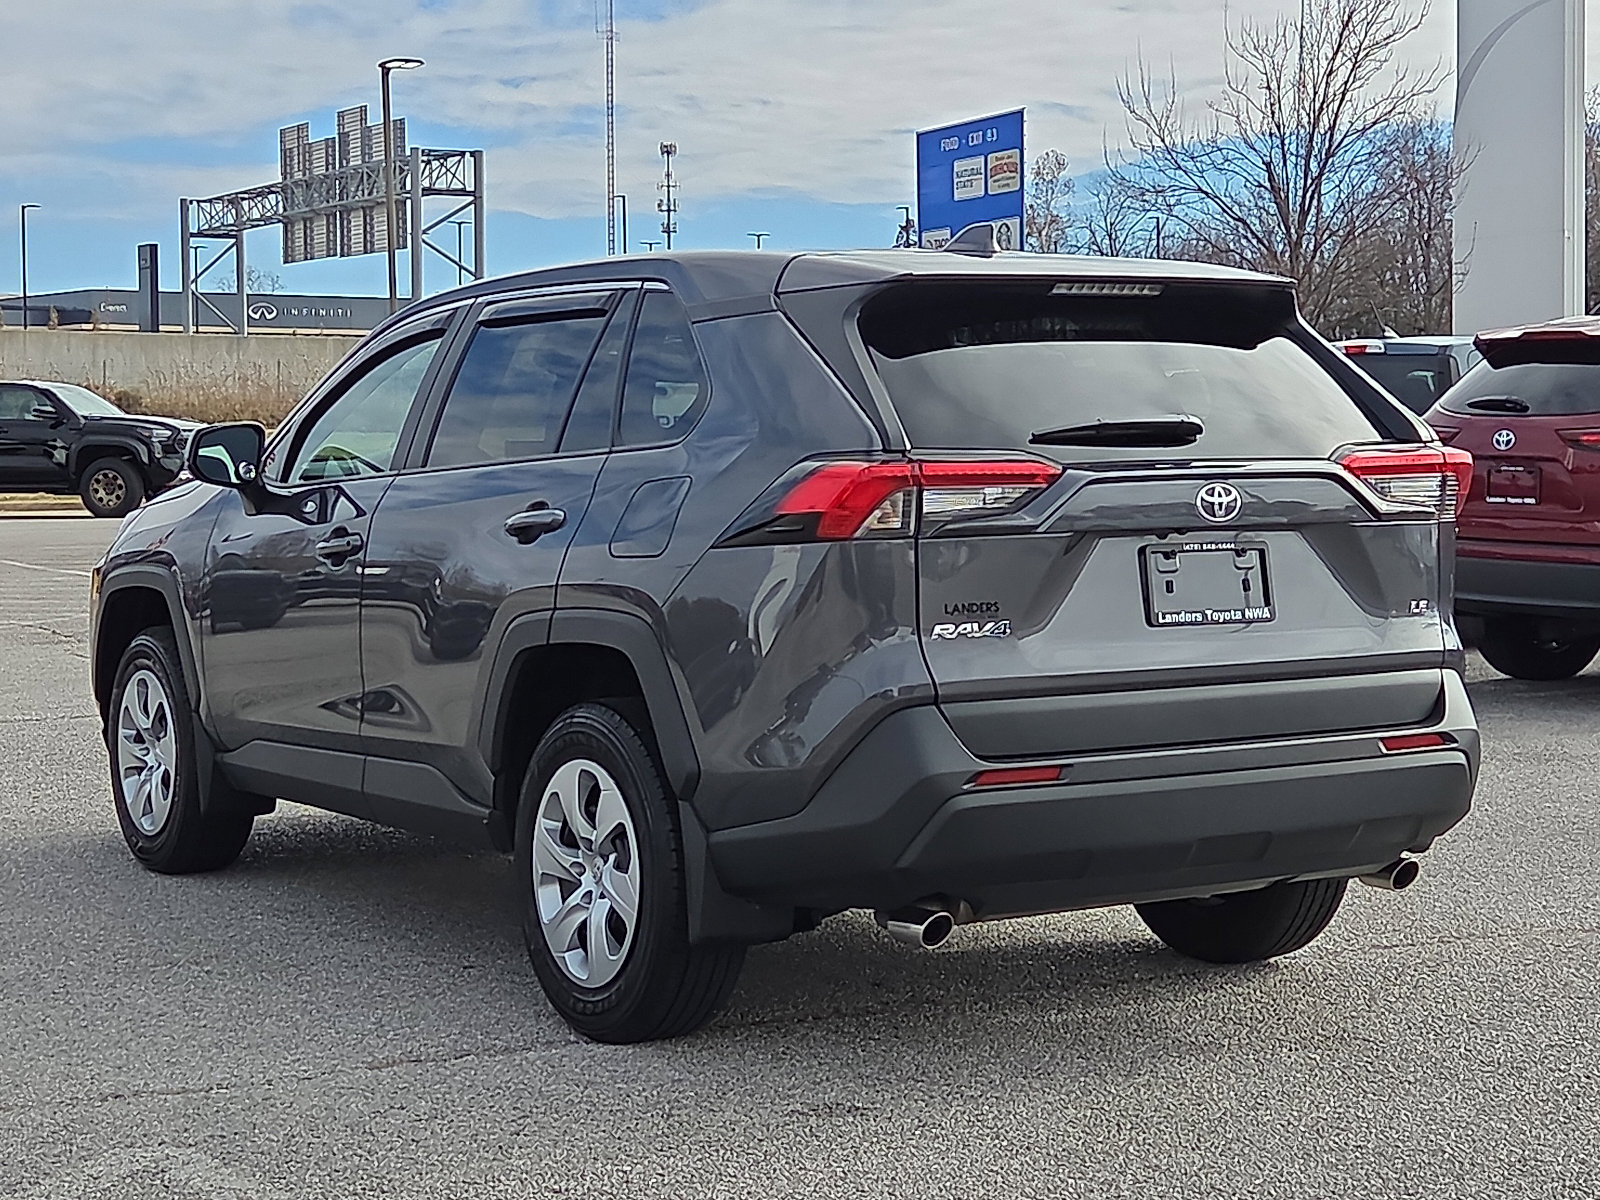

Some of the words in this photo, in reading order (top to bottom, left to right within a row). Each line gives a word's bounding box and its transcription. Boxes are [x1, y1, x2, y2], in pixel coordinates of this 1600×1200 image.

[940, 136, 960, 152] FOOD
[282, 307, 352, 318] INFINITI
[943, 601, 1001, 617] LANDERS
[1158, 611, 1203, 624] Landers
[1204, 609, 1243, 622] Toyota
[1244, 607, 1272, 620] NWA
[930, 619, 1011, 640] RAV4
